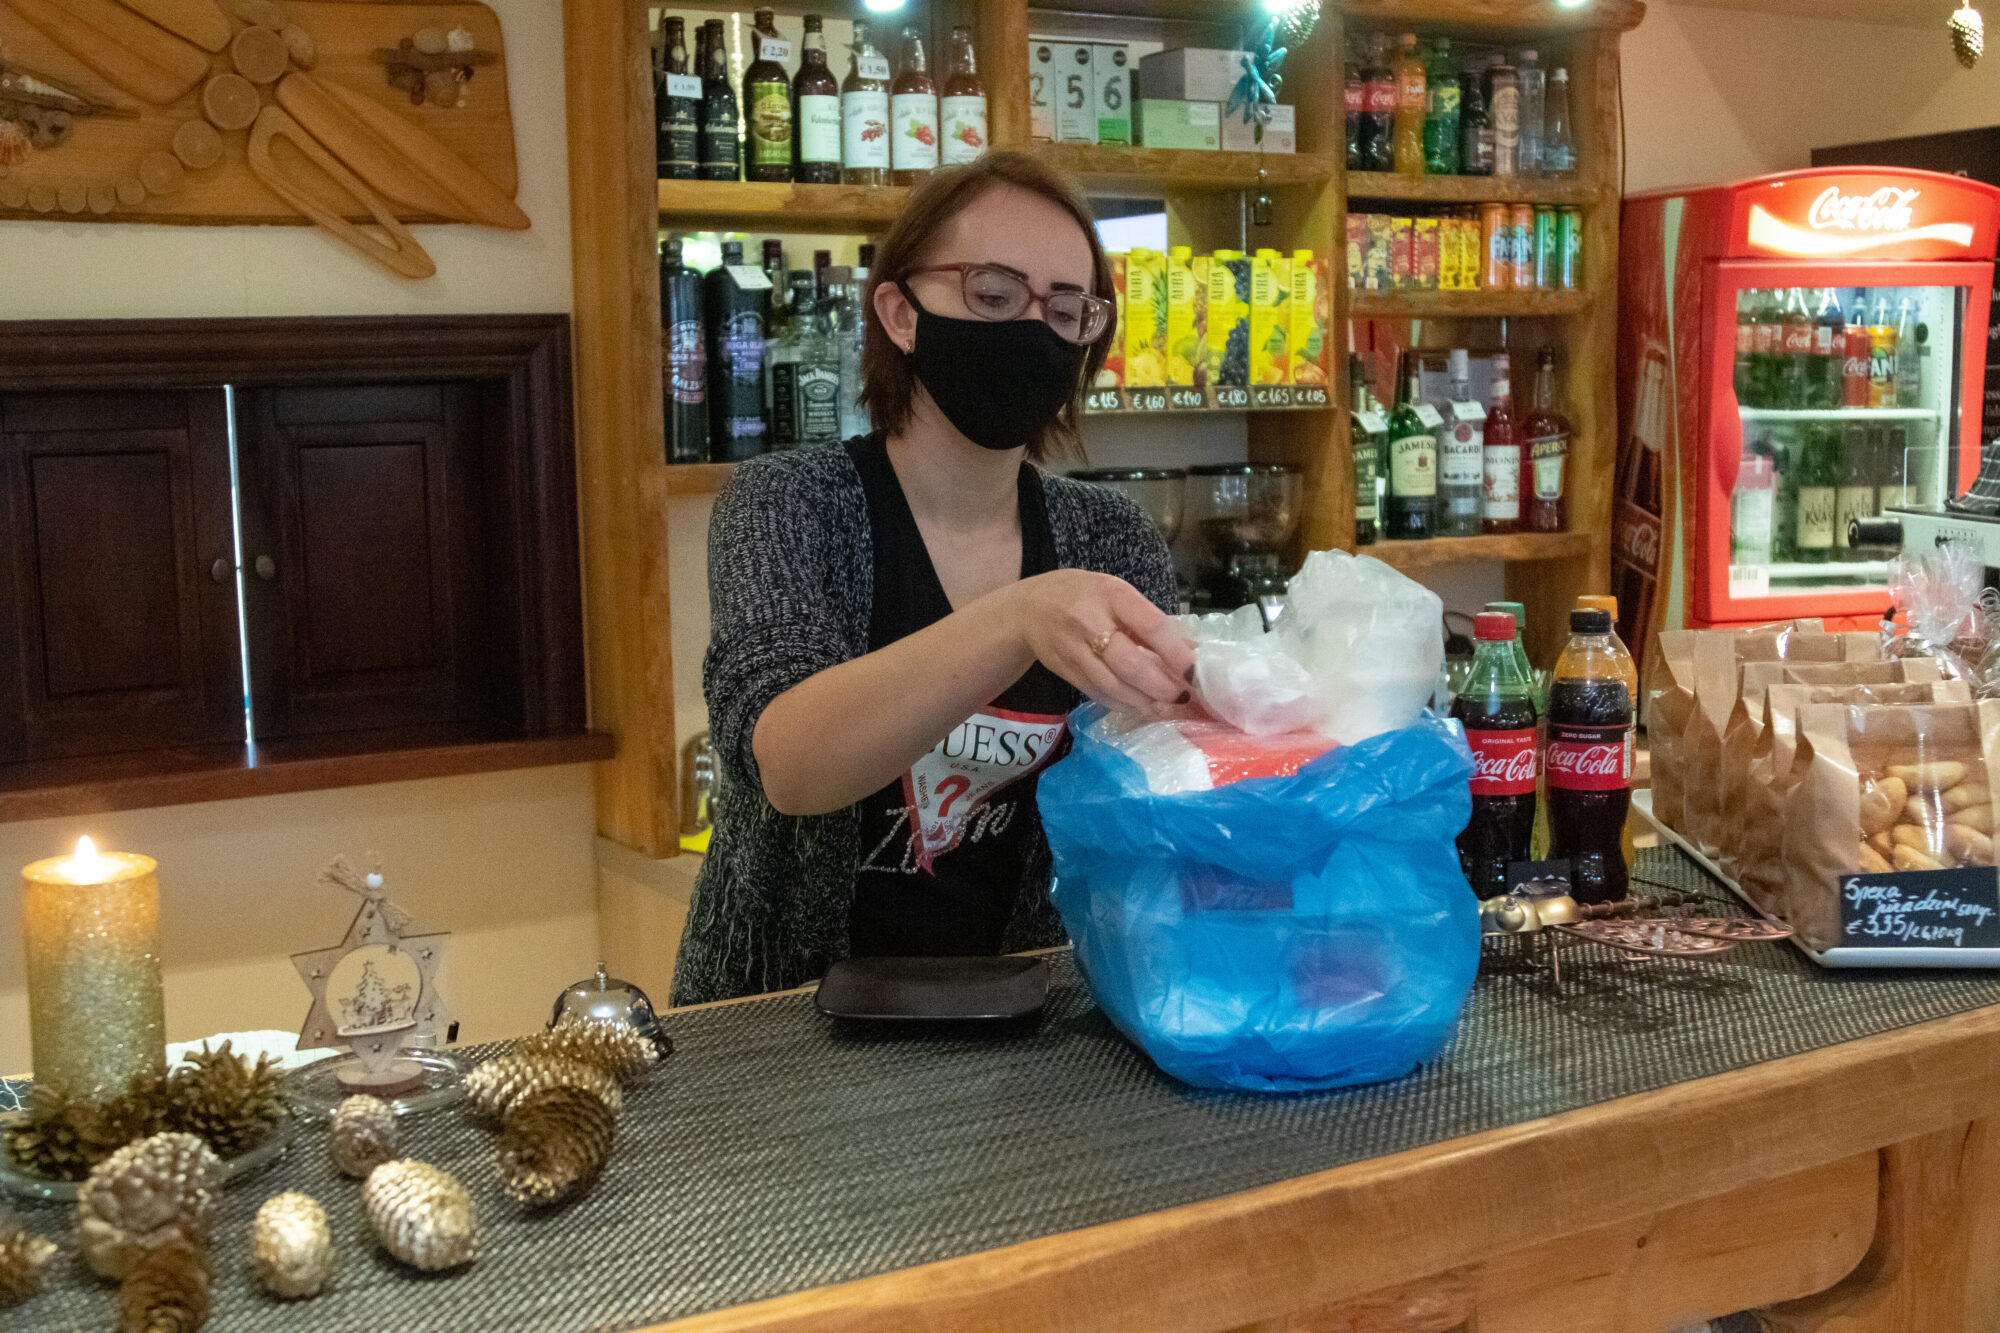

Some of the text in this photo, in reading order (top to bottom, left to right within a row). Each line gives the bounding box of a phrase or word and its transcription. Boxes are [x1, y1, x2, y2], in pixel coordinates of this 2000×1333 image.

[1067, 75, 1085, 109] 5
[1104, 75, 1122, 110] 6
[1807, 186, 1921, 230] Coca-Cola
[1130, 270, 1142, 300] AURA
[1172, 270, 1184, 300] AURA
[1211, 271, 1224, 300] AURA
[1255, 271, 1269, 301] AURA
[1295, 271, 1307, 301] AURA
[1089, 394, 1099, 408] €
[1134, 394, 1144, 409] €
[1173, 392, 1183, 404] €
[1218, 392, 1228, 404] €
[1258, 390, 1268, 403] €
[942, 721, 1043, 767] UESS
[1546, 743, 1622, 775] Coca-Cola
